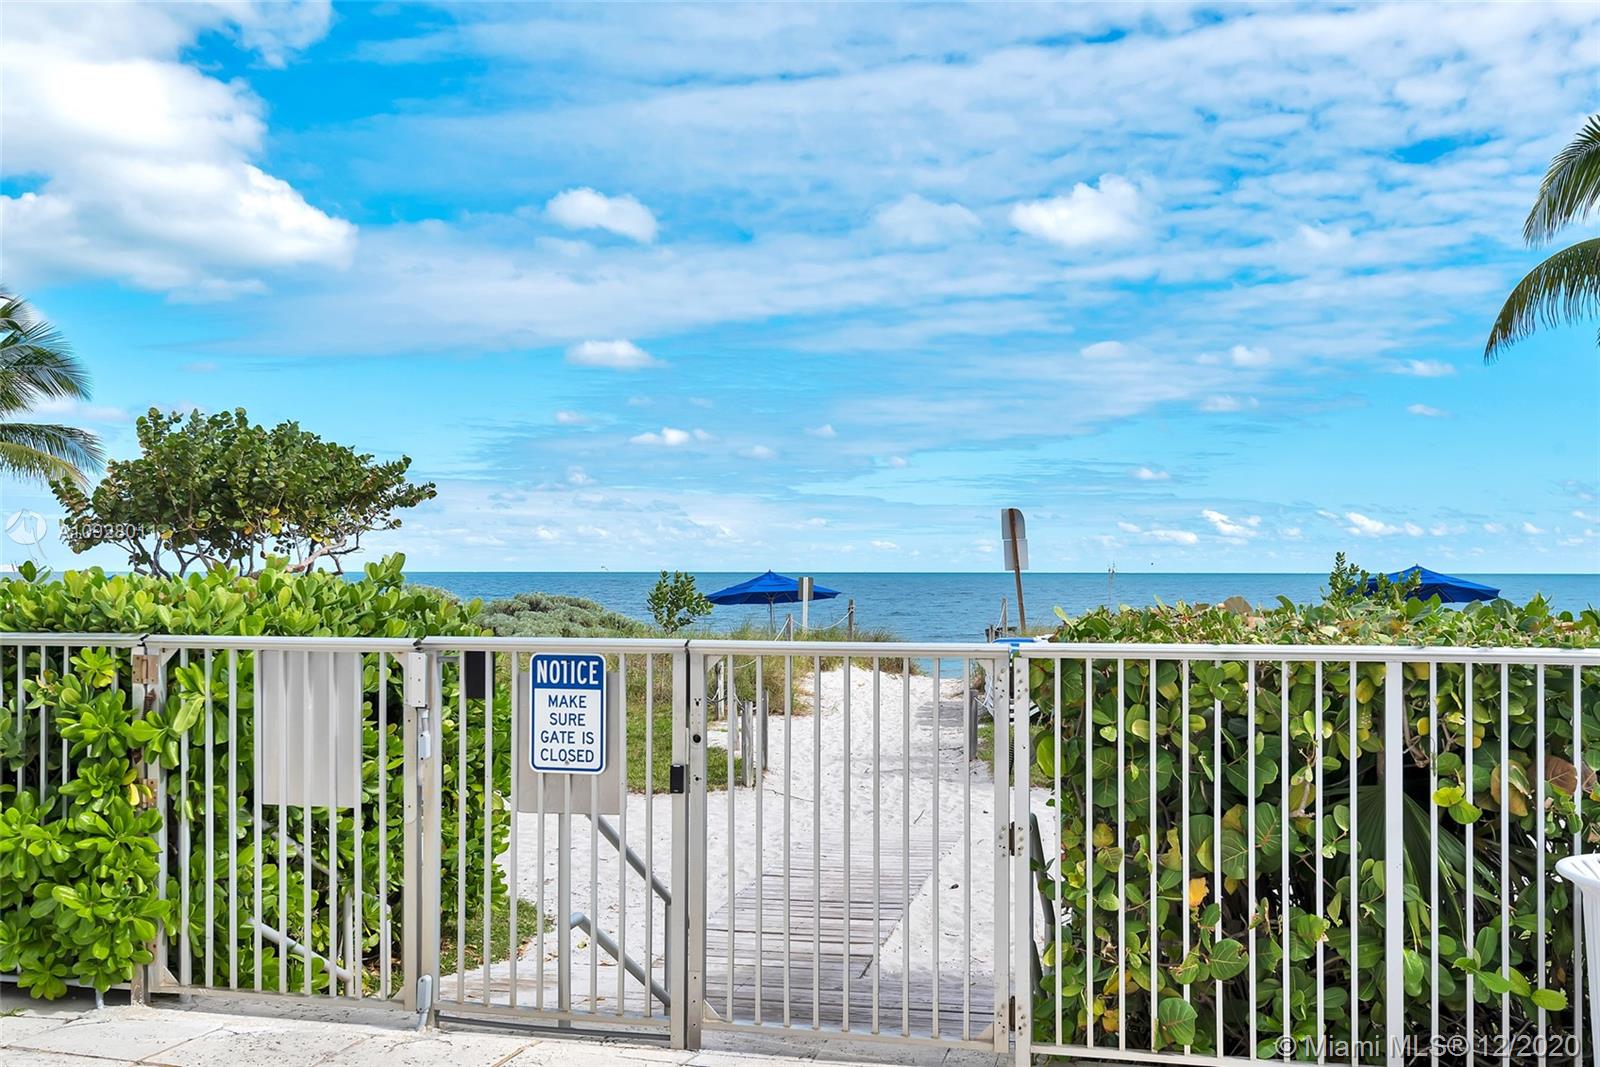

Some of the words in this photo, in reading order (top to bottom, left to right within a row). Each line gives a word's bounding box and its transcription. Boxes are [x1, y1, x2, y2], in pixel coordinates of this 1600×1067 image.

[537, 660, 599, 685] NOTICE
[548, 694, 587, 709] MAKE
[549, 712, 586, 727] SURE
[540, 730, 576, 744] GATE
[582, 731, 595, 745] IS
[540, 748, 595, 763] CLOSED
